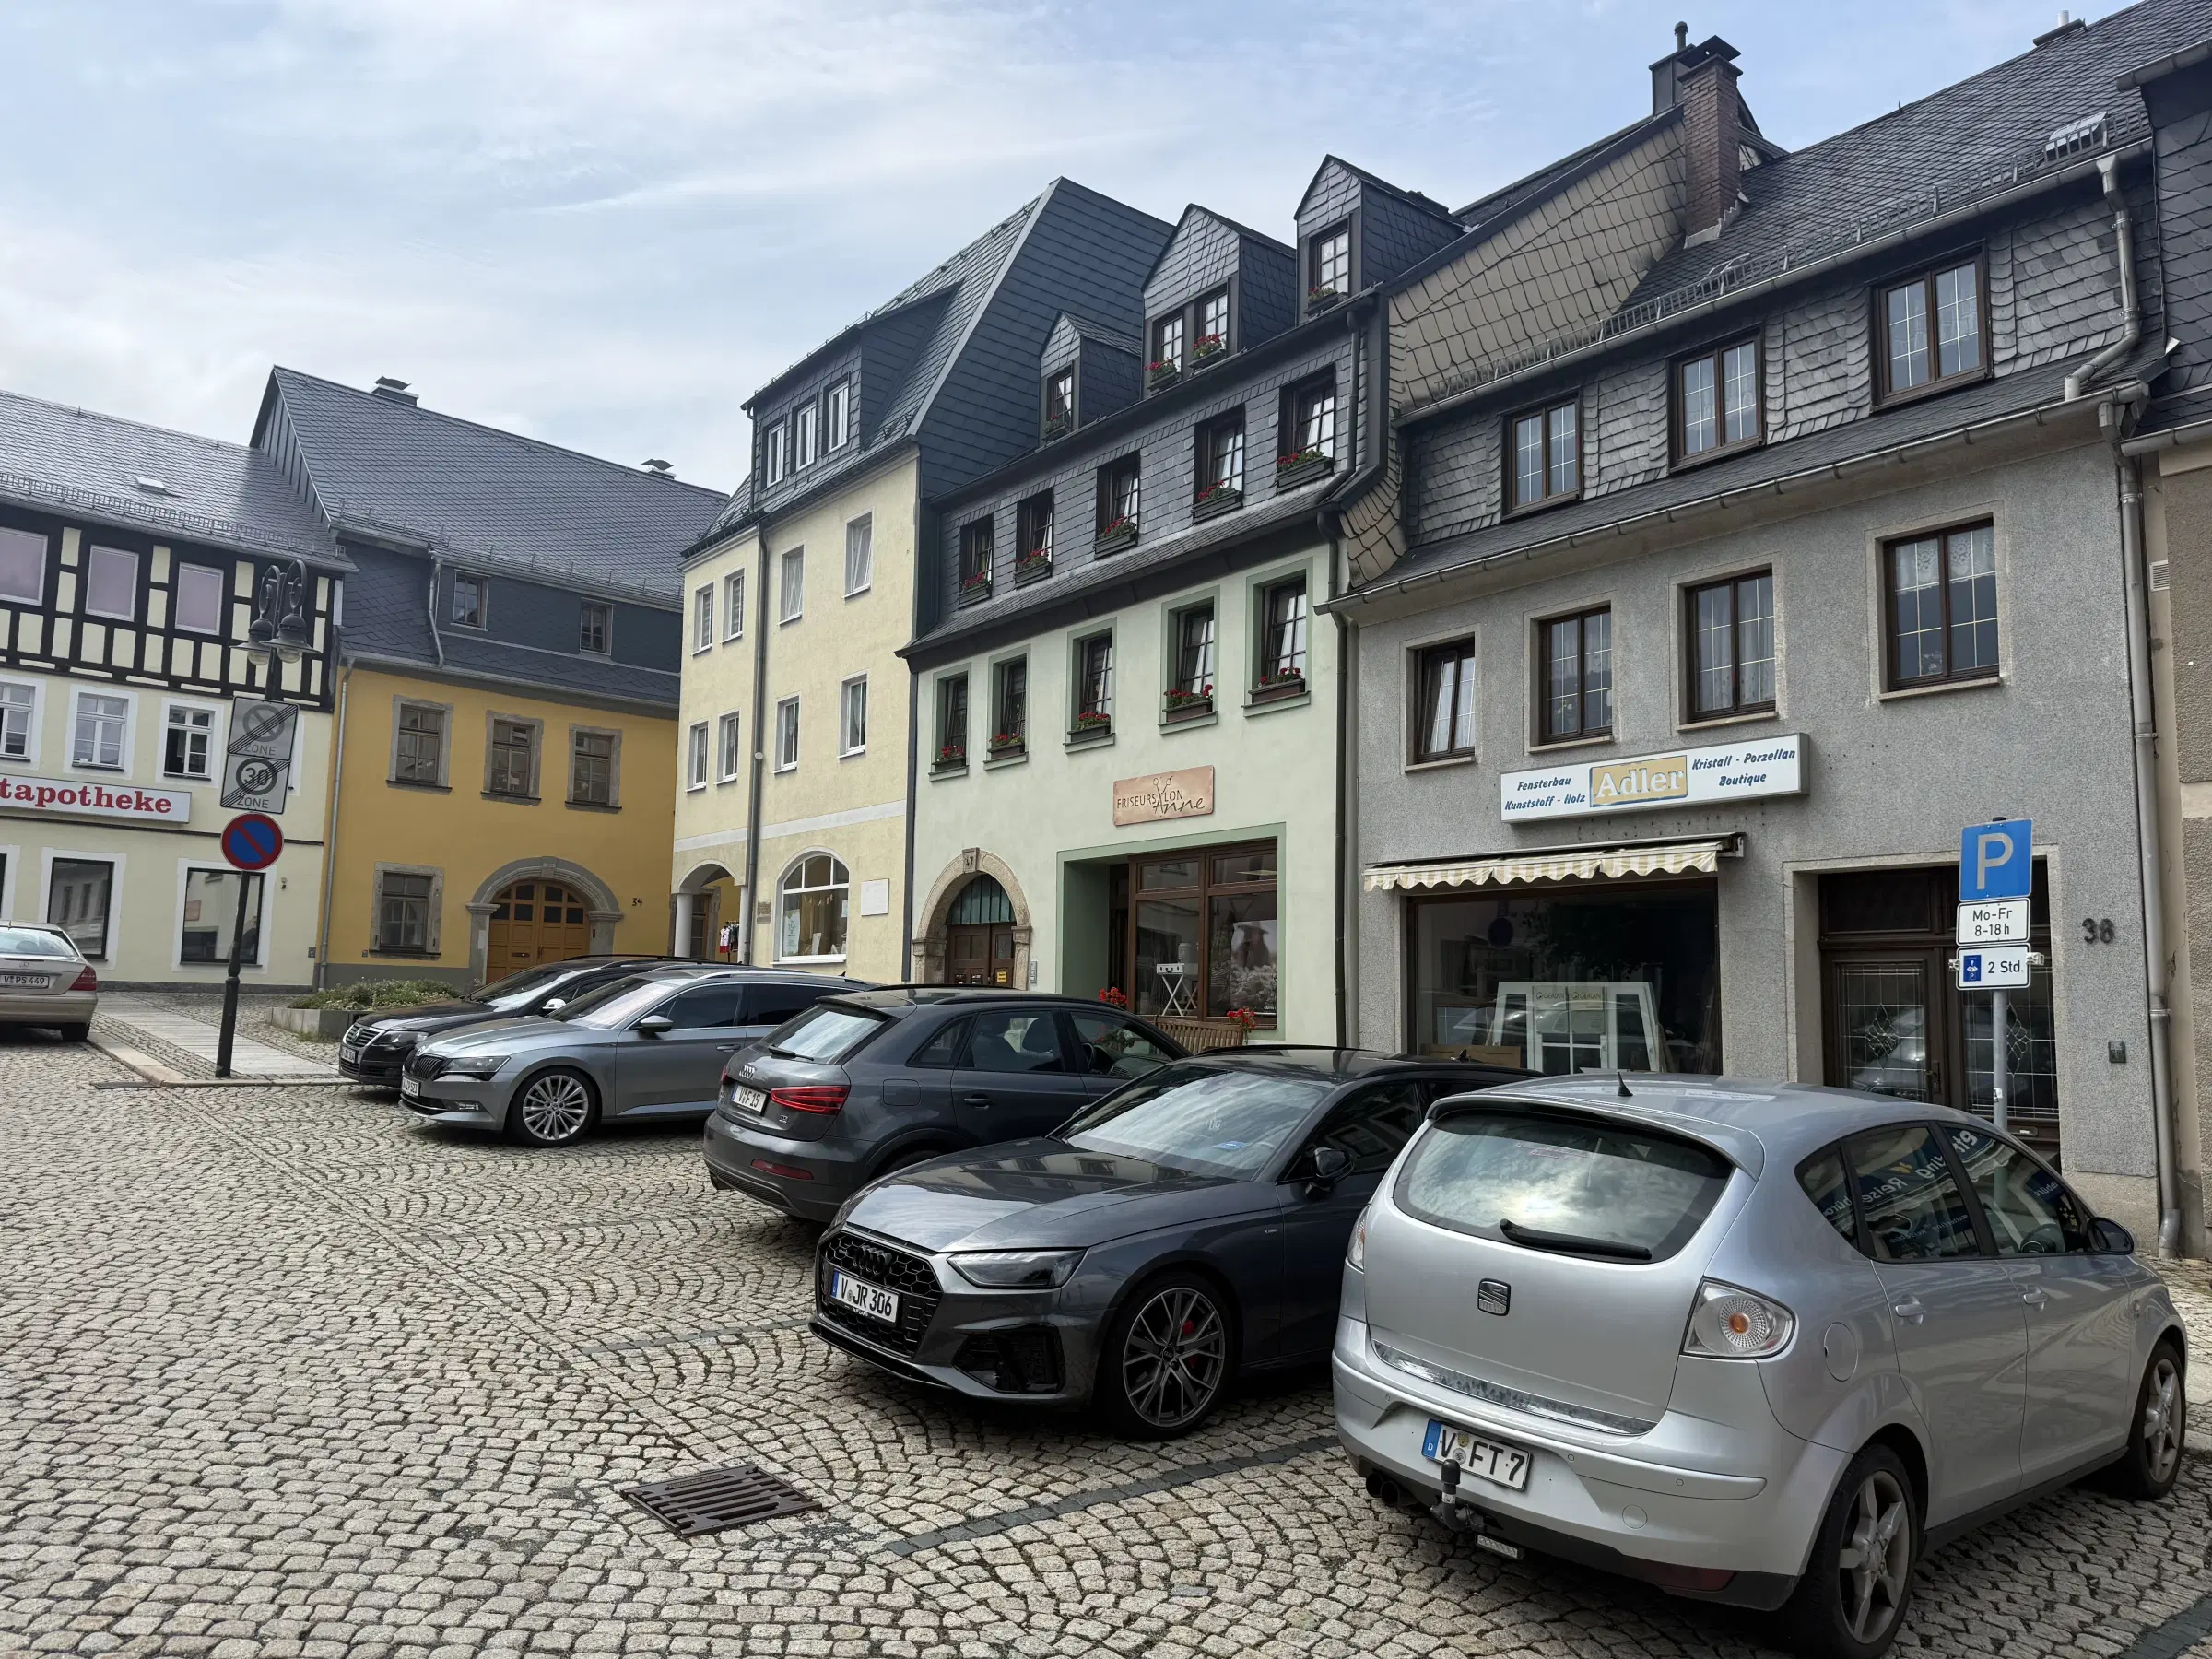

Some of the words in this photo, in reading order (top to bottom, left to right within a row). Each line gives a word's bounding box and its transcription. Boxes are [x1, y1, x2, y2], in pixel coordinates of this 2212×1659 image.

[244, 744, 276, 756] ZONE
[1691, 755, 1733, 771] Kristall
[1743, 748, 1796, 764] Porzellan
[243, 767, 269, 786] 30
[1594, 768, 1685, 799] Adler
[1718, 772, 1767, 787] Boutique
[1516, 777, 1571, 792] Fensterbau
[236, 795, 270, 809] ZONE
[1504, 795, 1556, 811] Kunststoff
[1563, 793, 1586, 805] Holz
[1976, 832, 2014, 890] P
[631, 898, 643, 907] 34
[1972, 907, 2013, 922] Mo-Fr
[2081, 917, 2115, 944] 38
[1987, 961, 1995, 974] 2
[1999, 959, 2025, 973] Std.
[29, 977, 45, 985] 449
[749, 1093, 761, 1108] 15
[841, 1277, 849, 1300] V
[853, 1283, 868, 1309] JR
[869, 1288, 892, 1317] 306
[1427, 1442, 1434, 1452] D
[1441, 1429, 1457, 1458] V
[1468, 1440, 1505, 1476] FT
[1508, 1452, 1525, 1482] 7
